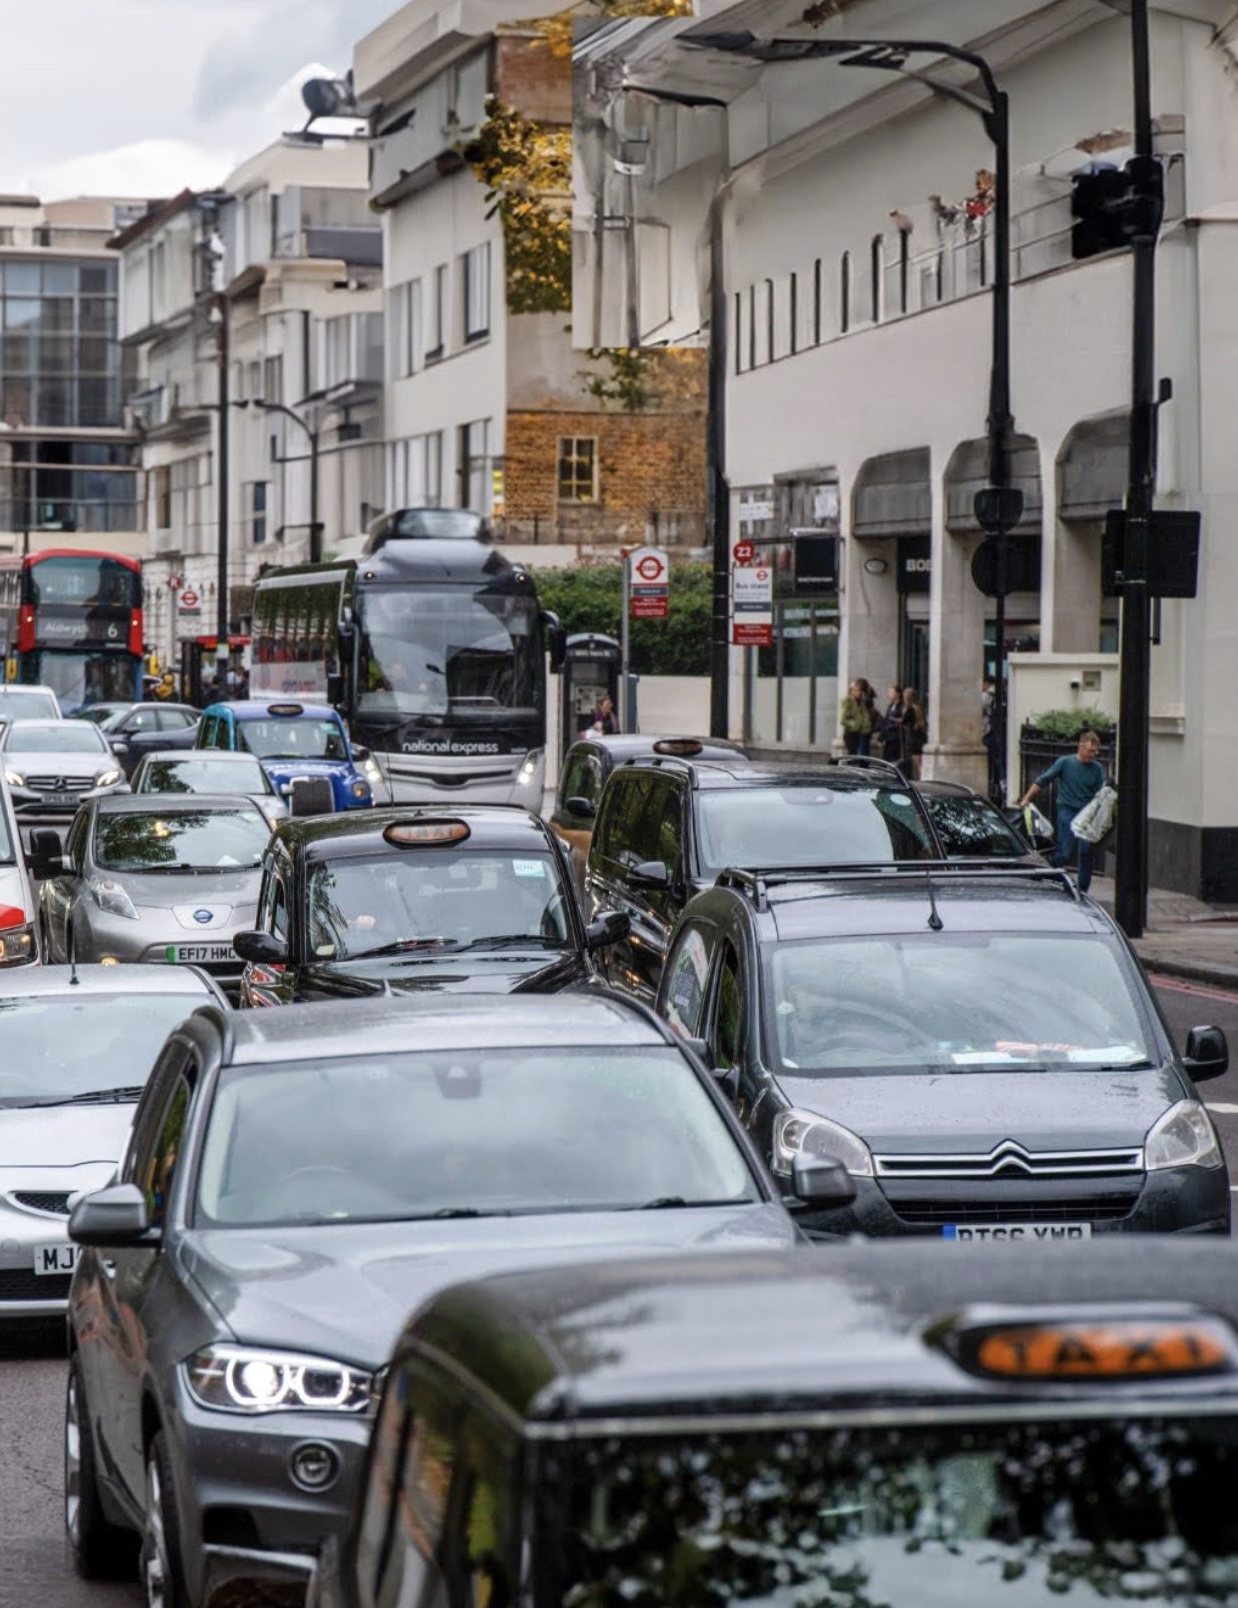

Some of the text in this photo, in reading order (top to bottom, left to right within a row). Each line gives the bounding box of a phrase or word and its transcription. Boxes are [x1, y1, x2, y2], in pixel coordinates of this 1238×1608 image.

[107, 623, 118, 639] 6
[402, 739, 450, 753] national
[450, 743, 499, 755] express
[178, 946, 208, 961] EF17
[998, 1334, 1202, 1372] TAXI
